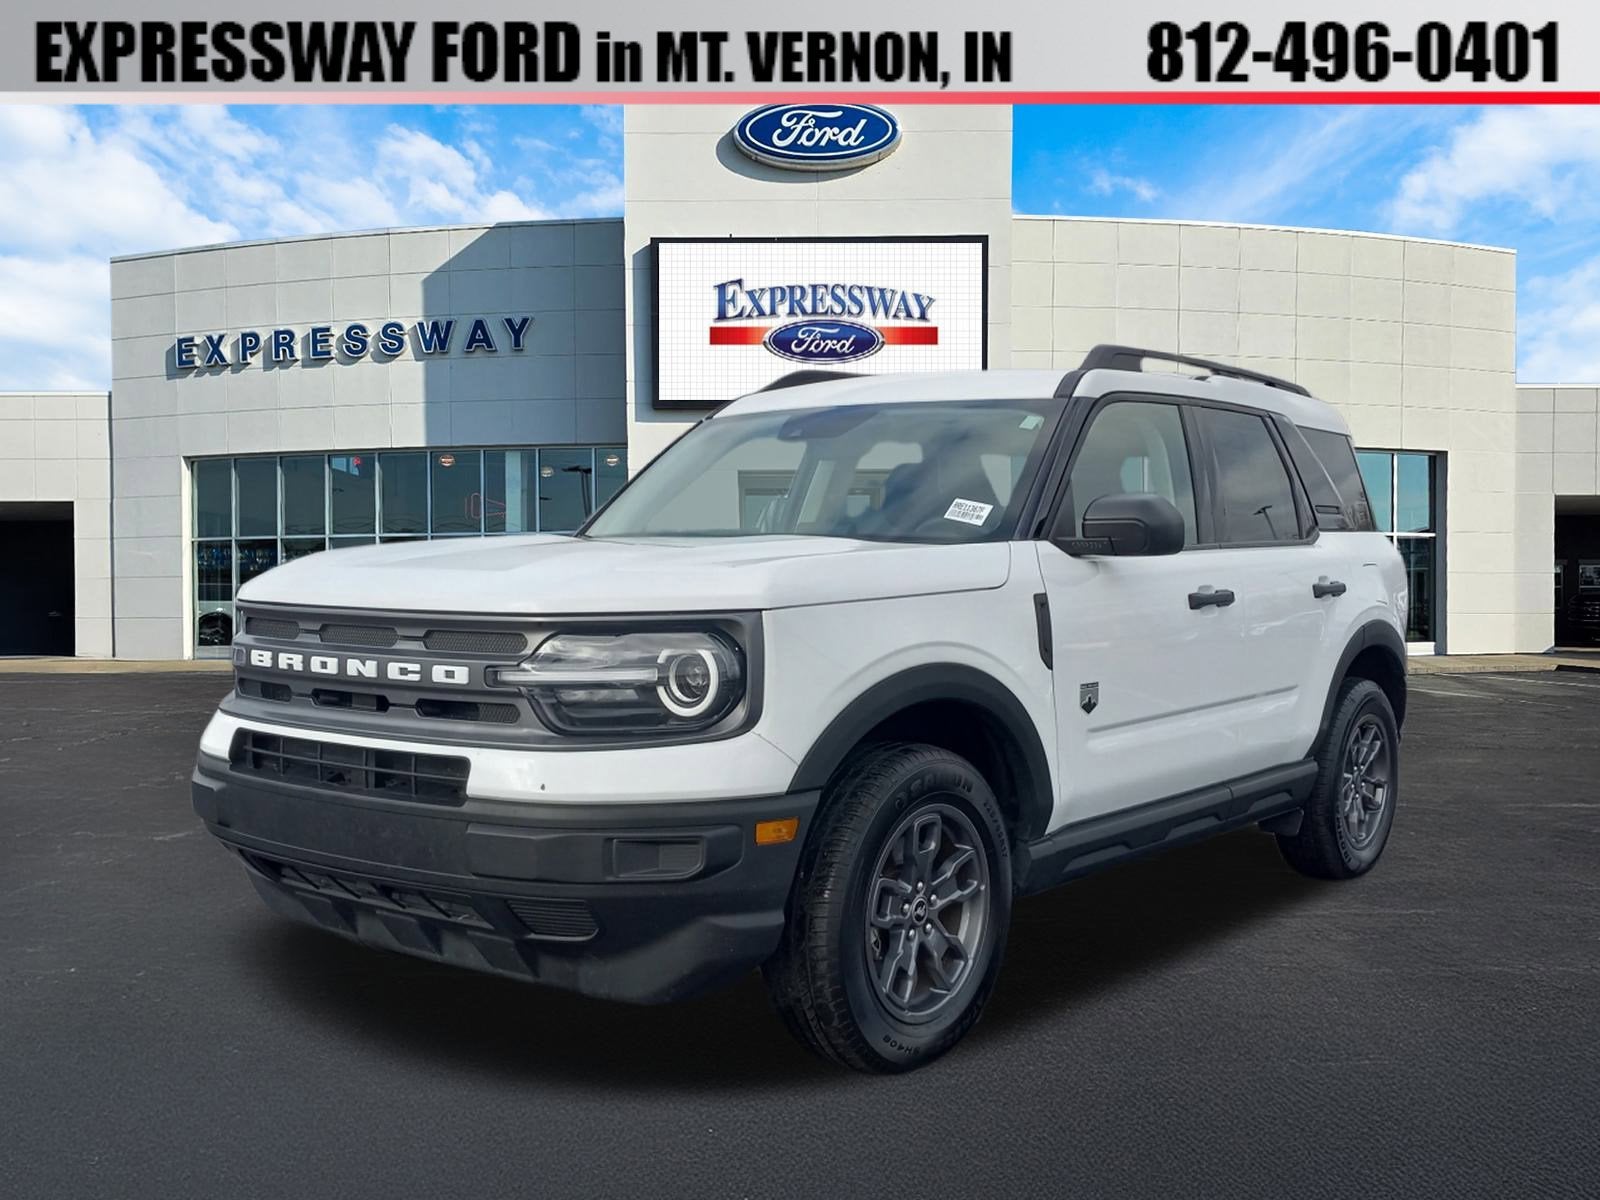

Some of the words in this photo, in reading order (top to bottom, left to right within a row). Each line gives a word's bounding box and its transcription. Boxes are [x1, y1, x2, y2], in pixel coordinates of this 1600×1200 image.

[772, 110, 868, 147] Ford
[713, 278, 936, 322] EXPRESSWAY
[175, 315, 533, 368] EXPRESSWAY
[790, 327, 855, 353] Ford
[249, 649, 470, 685] BRONCO
